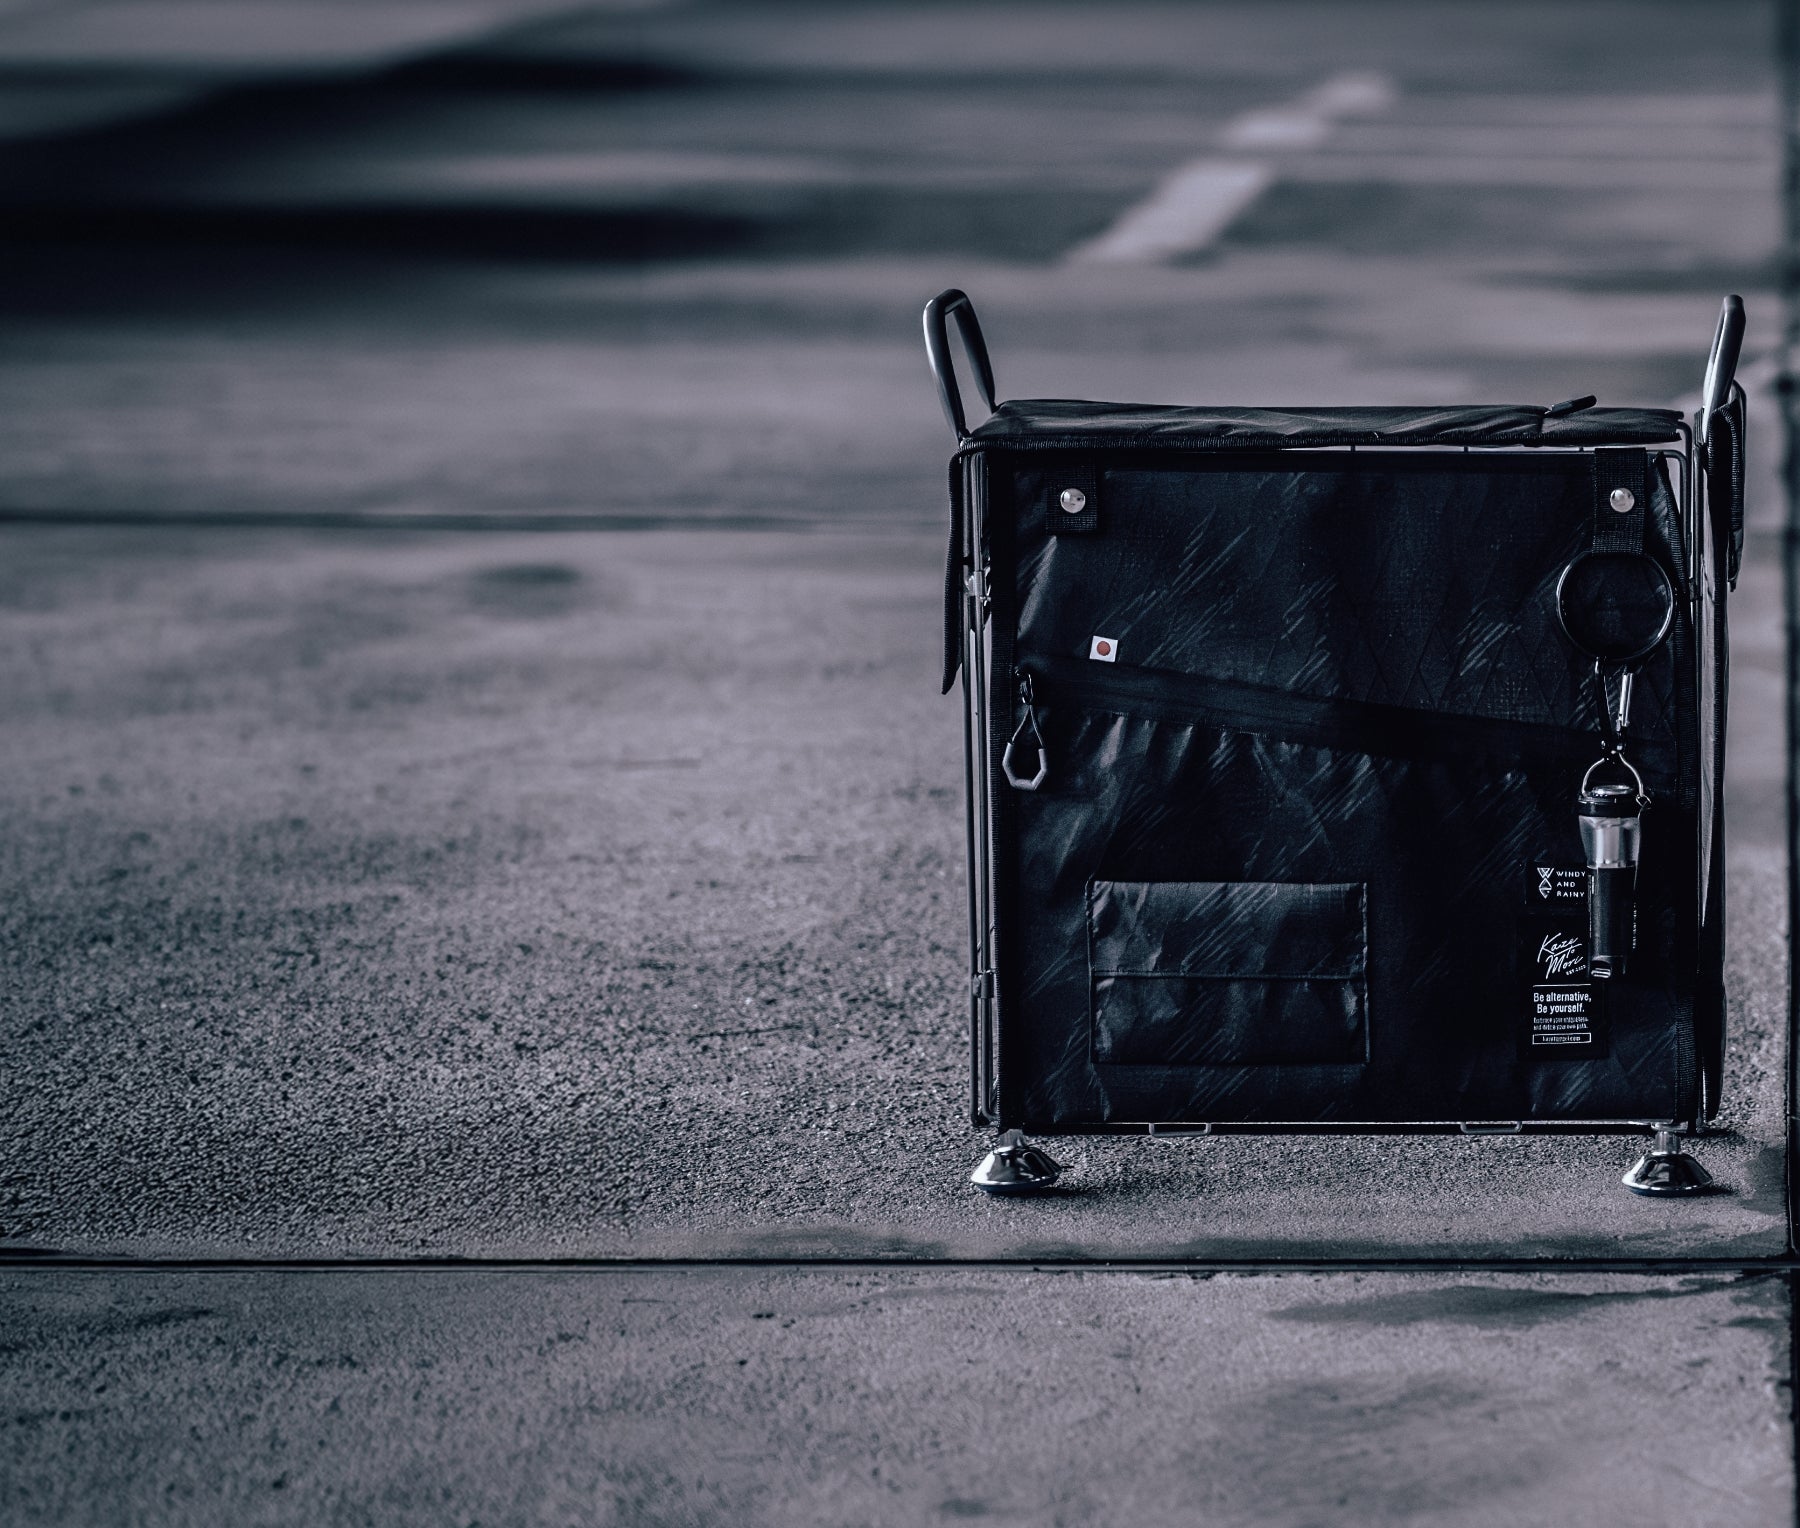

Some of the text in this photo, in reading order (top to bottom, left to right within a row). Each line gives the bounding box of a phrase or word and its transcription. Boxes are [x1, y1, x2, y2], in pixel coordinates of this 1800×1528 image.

[1556, 870, 1586, 878] WINDY
[1556, 890, 1585, 898] RAINY
[1537, 932, 1579, 963] Kaze
[1533, 991, 1592, 1003] Be alternative,
[1536, 1002, 1585, 1015] Be yourself.
